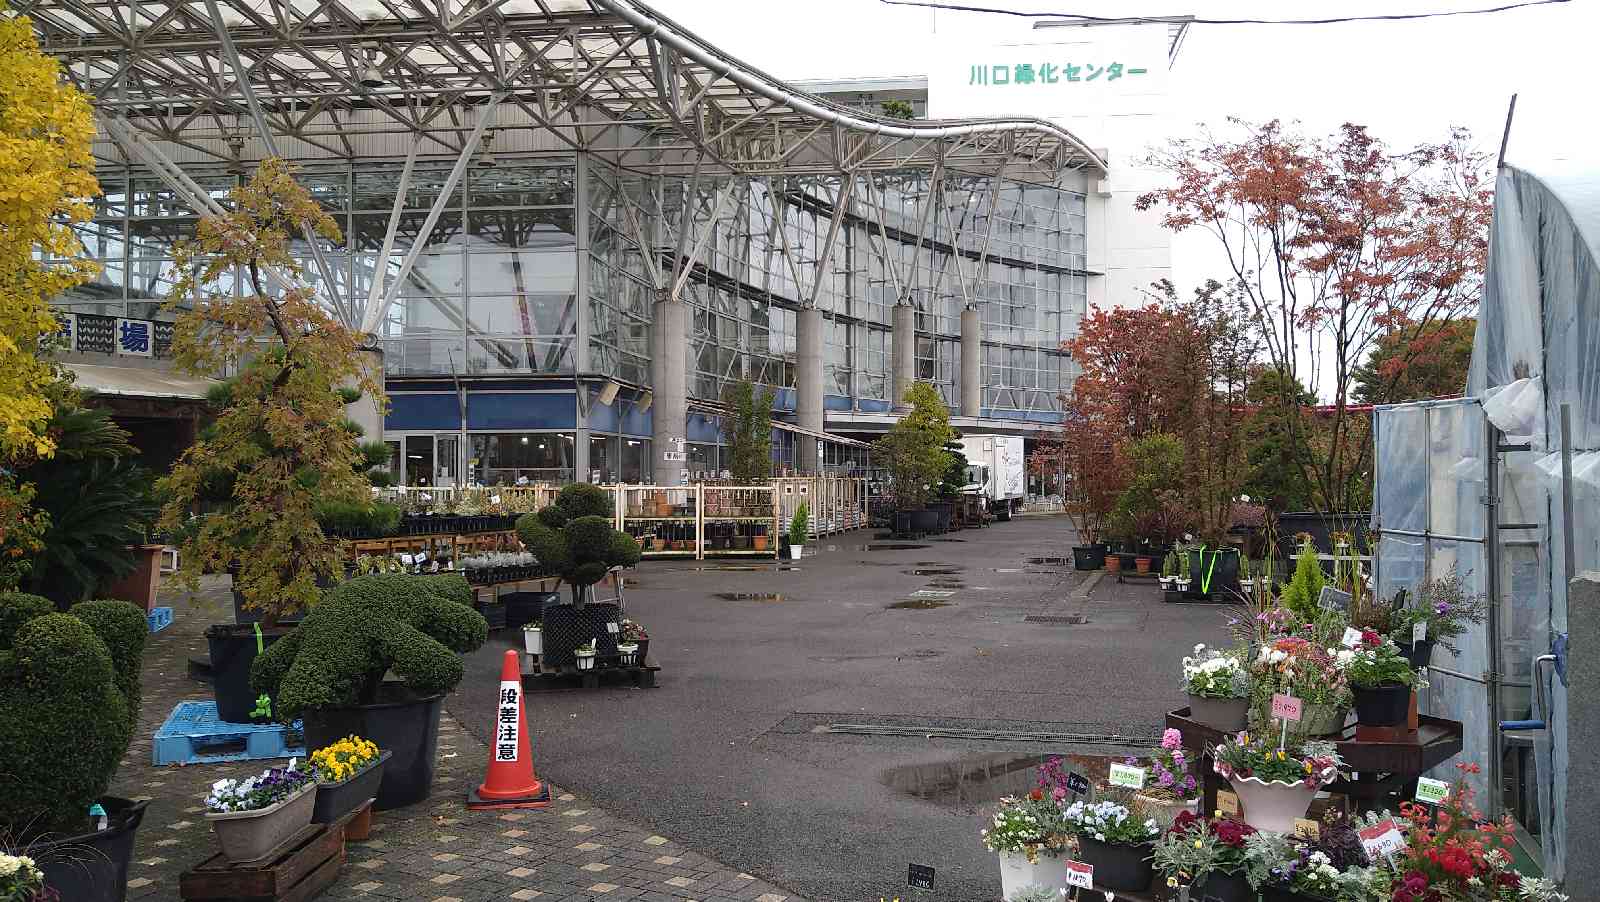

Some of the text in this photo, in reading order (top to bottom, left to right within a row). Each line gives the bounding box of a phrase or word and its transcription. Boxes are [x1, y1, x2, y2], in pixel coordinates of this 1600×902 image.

[969, 62, 1147, 86] 川口緑化センター
[119, 321, 149, 352] 場
[498, 688, 517, 760] 段差注意
